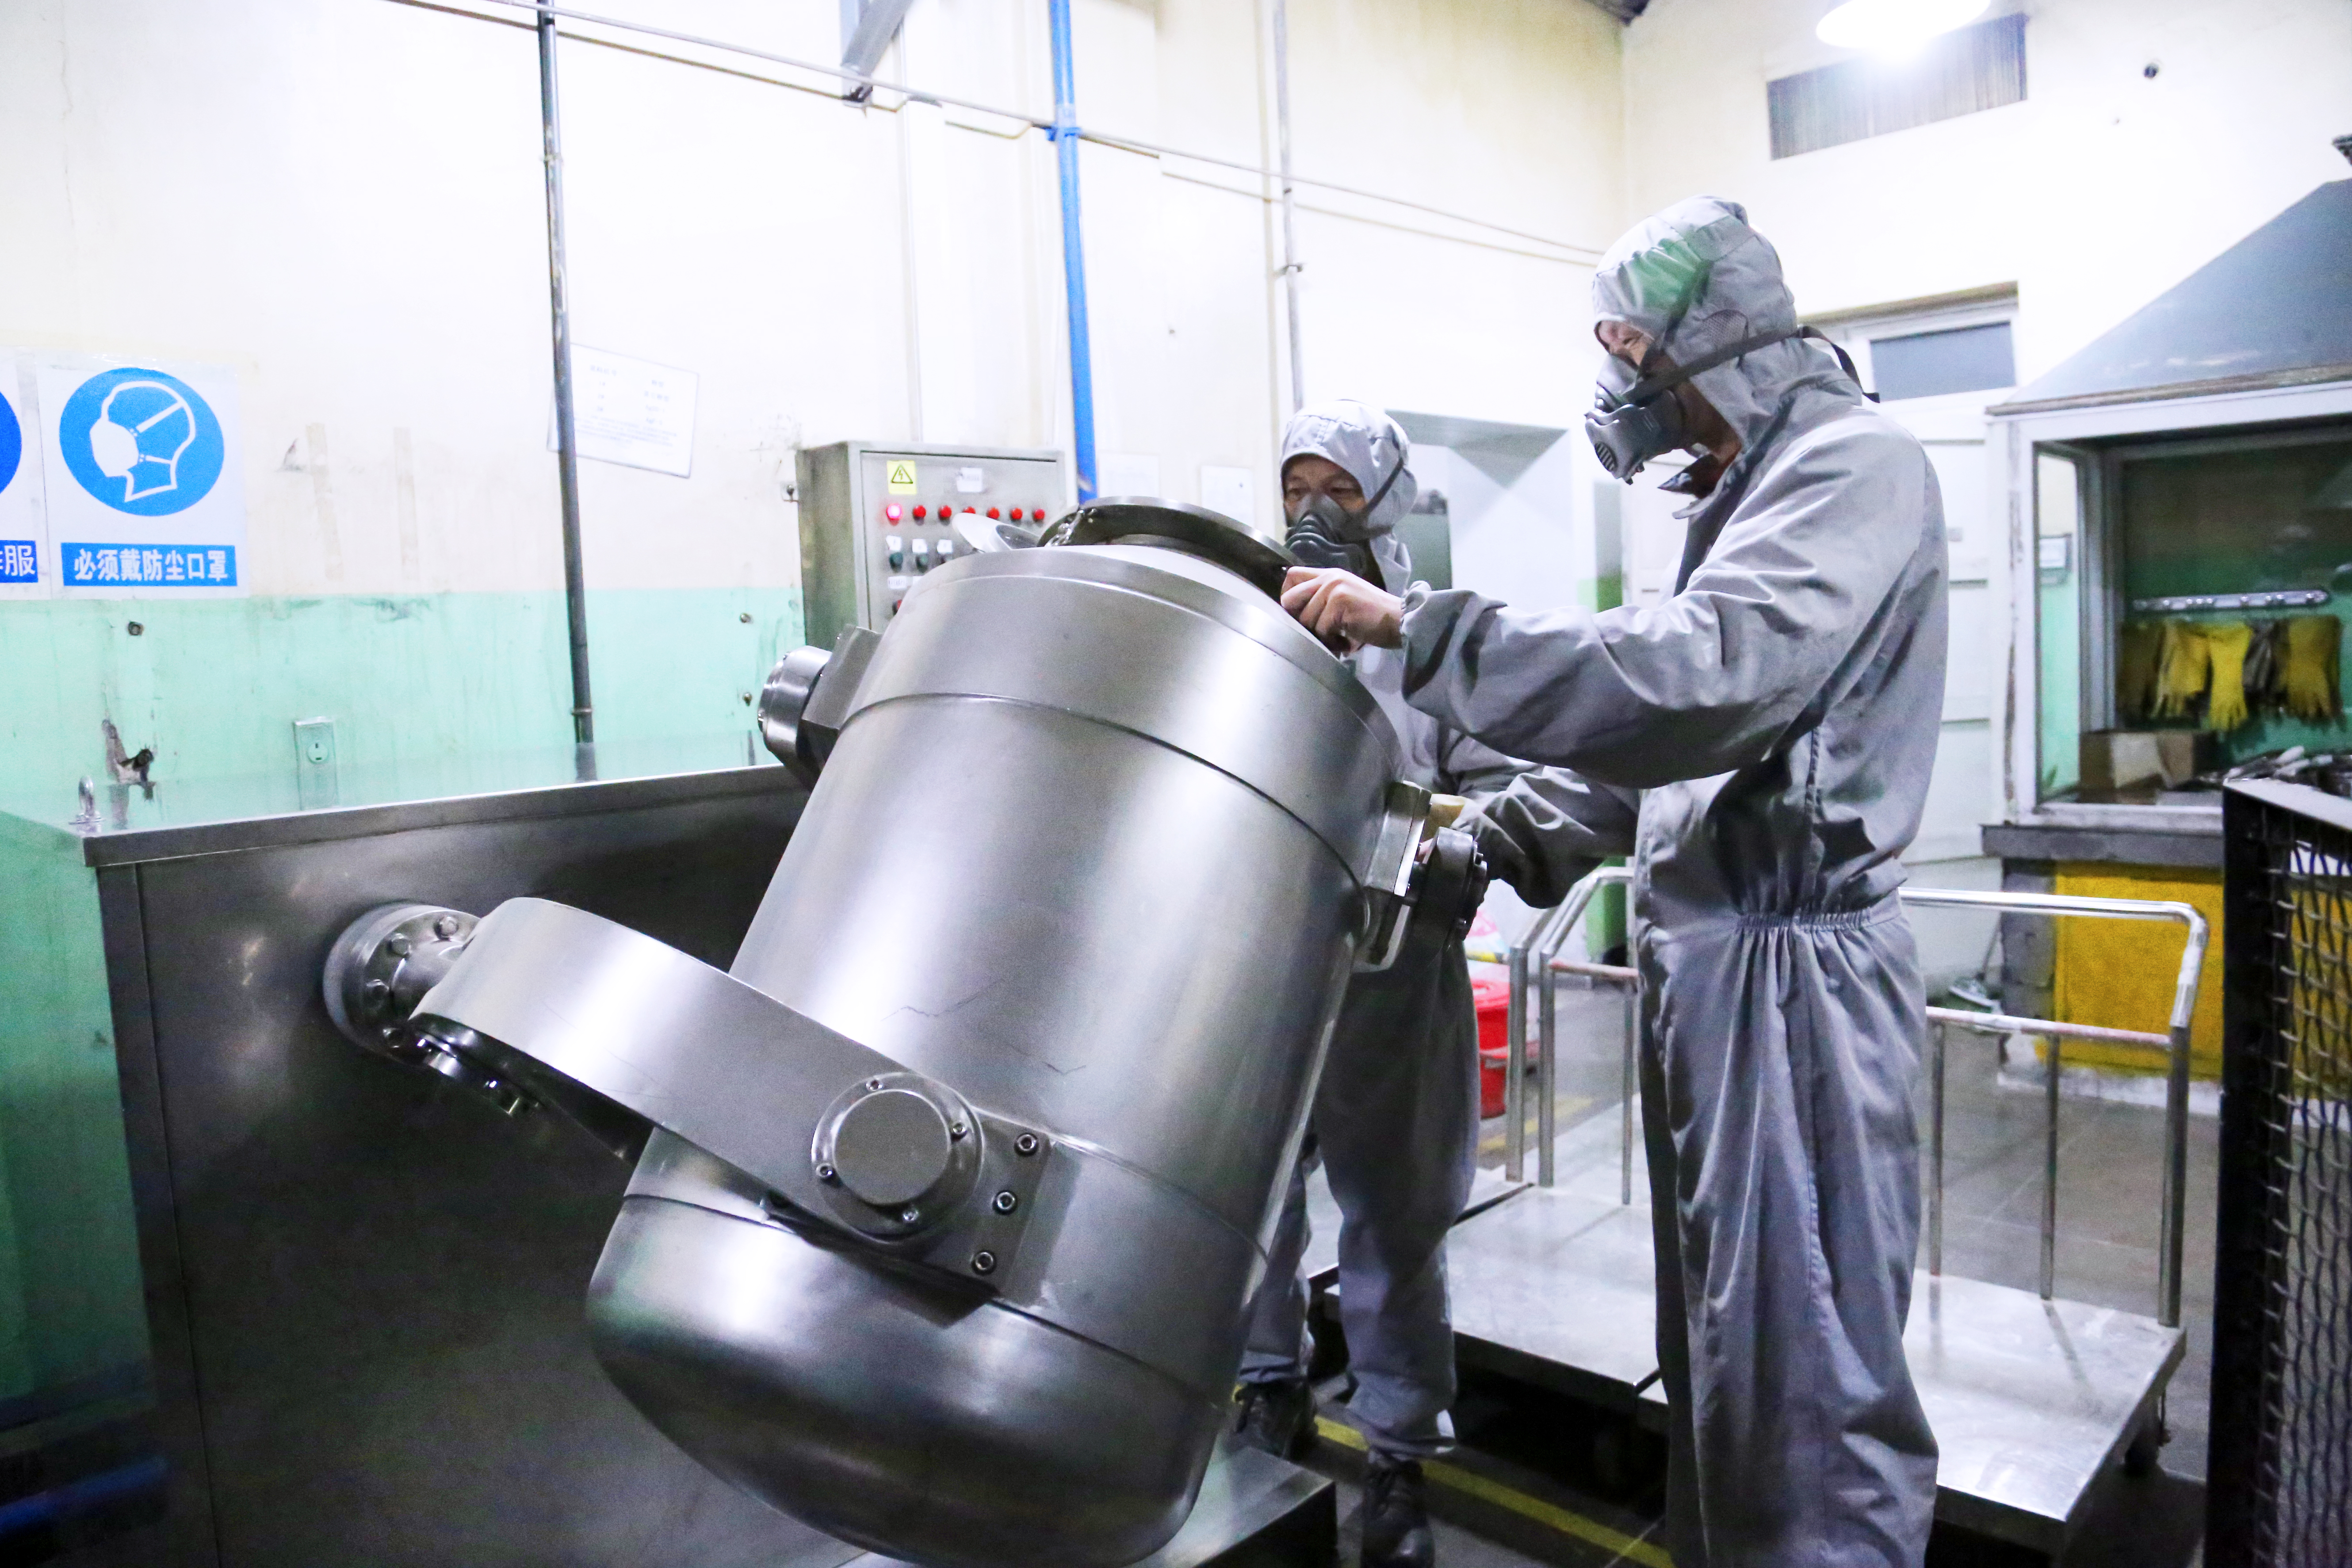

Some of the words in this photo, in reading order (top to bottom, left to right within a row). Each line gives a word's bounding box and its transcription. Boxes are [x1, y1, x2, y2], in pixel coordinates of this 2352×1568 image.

[0, 545, 35, 576] 服
[74, 548, 228, 581] 必须戴防尘口罩
